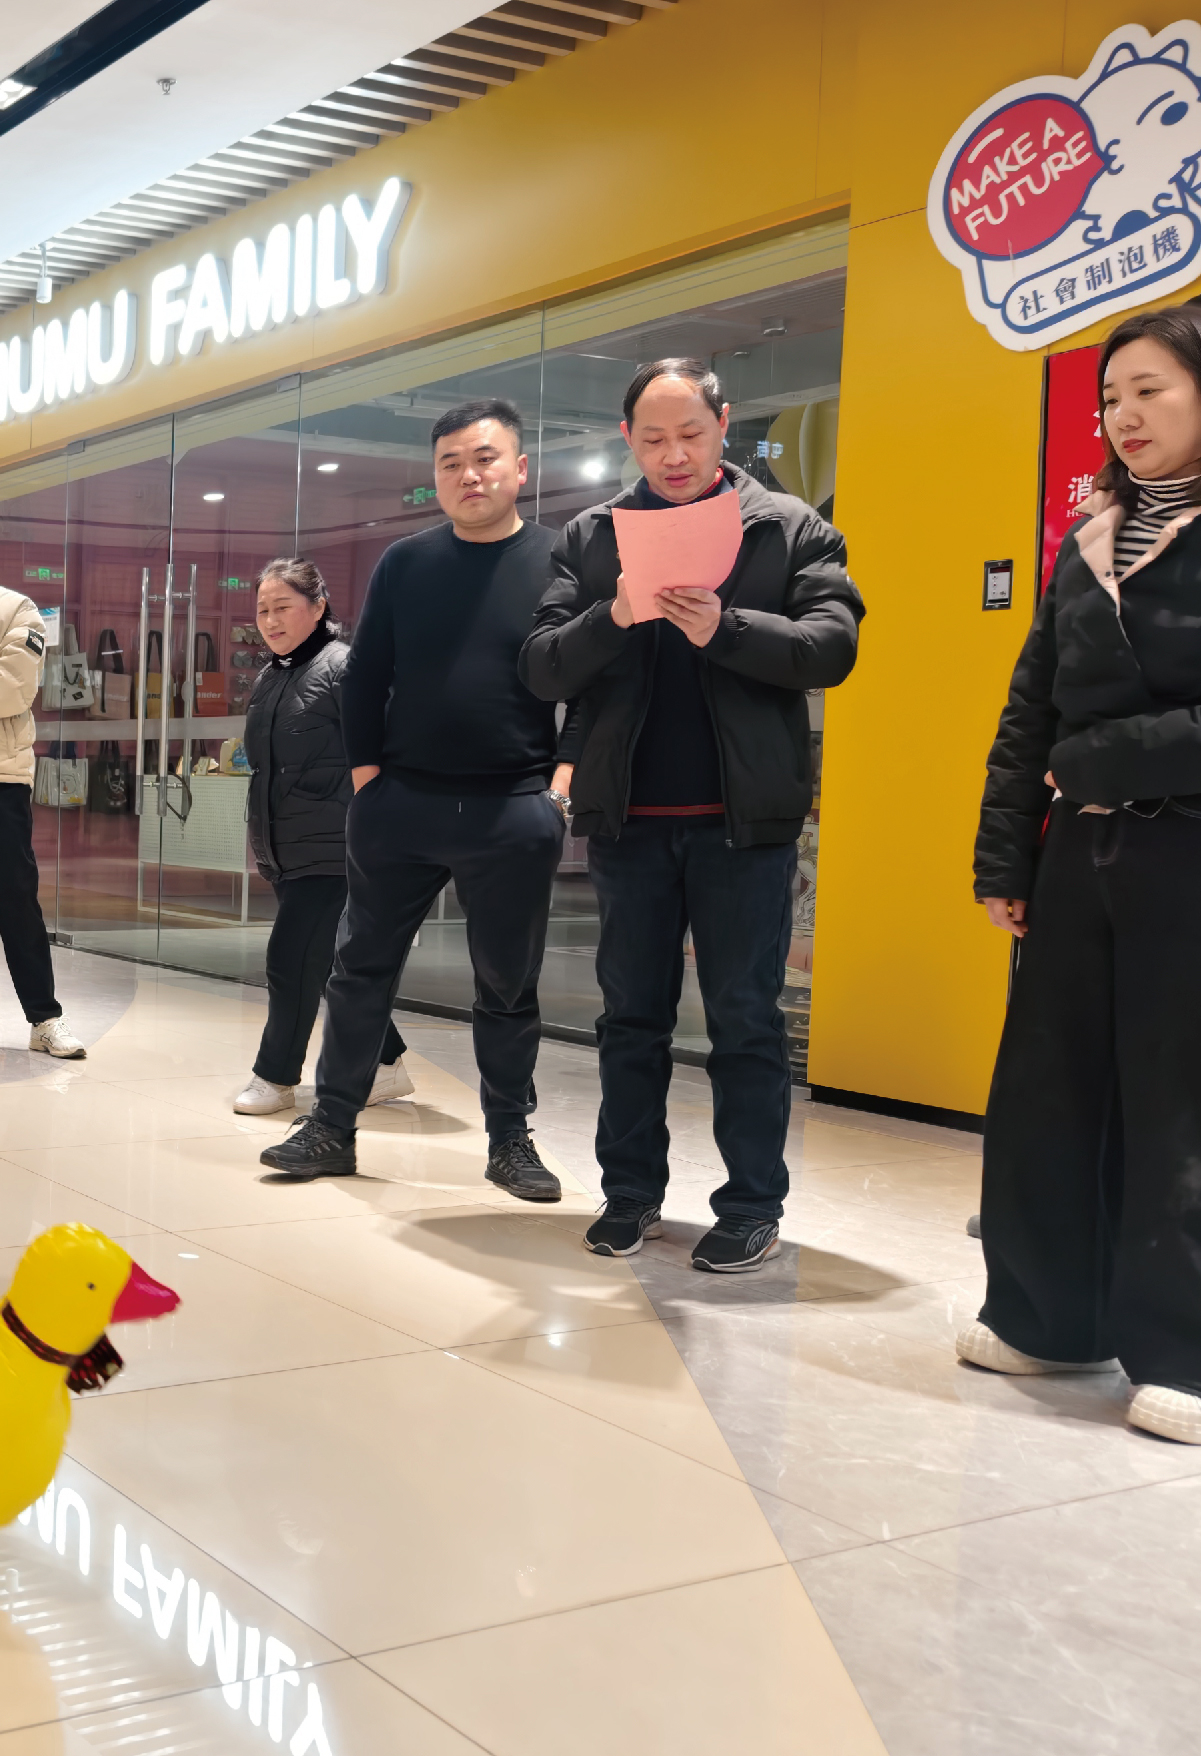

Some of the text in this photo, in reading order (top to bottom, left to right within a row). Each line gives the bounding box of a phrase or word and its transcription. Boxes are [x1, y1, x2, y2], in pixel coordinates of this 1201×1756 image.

[950, 118, 1065, 215] MAKE A
[964, 130, 1093, 241] FUTURE
[149, 177, 406, 366] FAMILY
[1018, 225, 1182, 322] 社會制泡機
